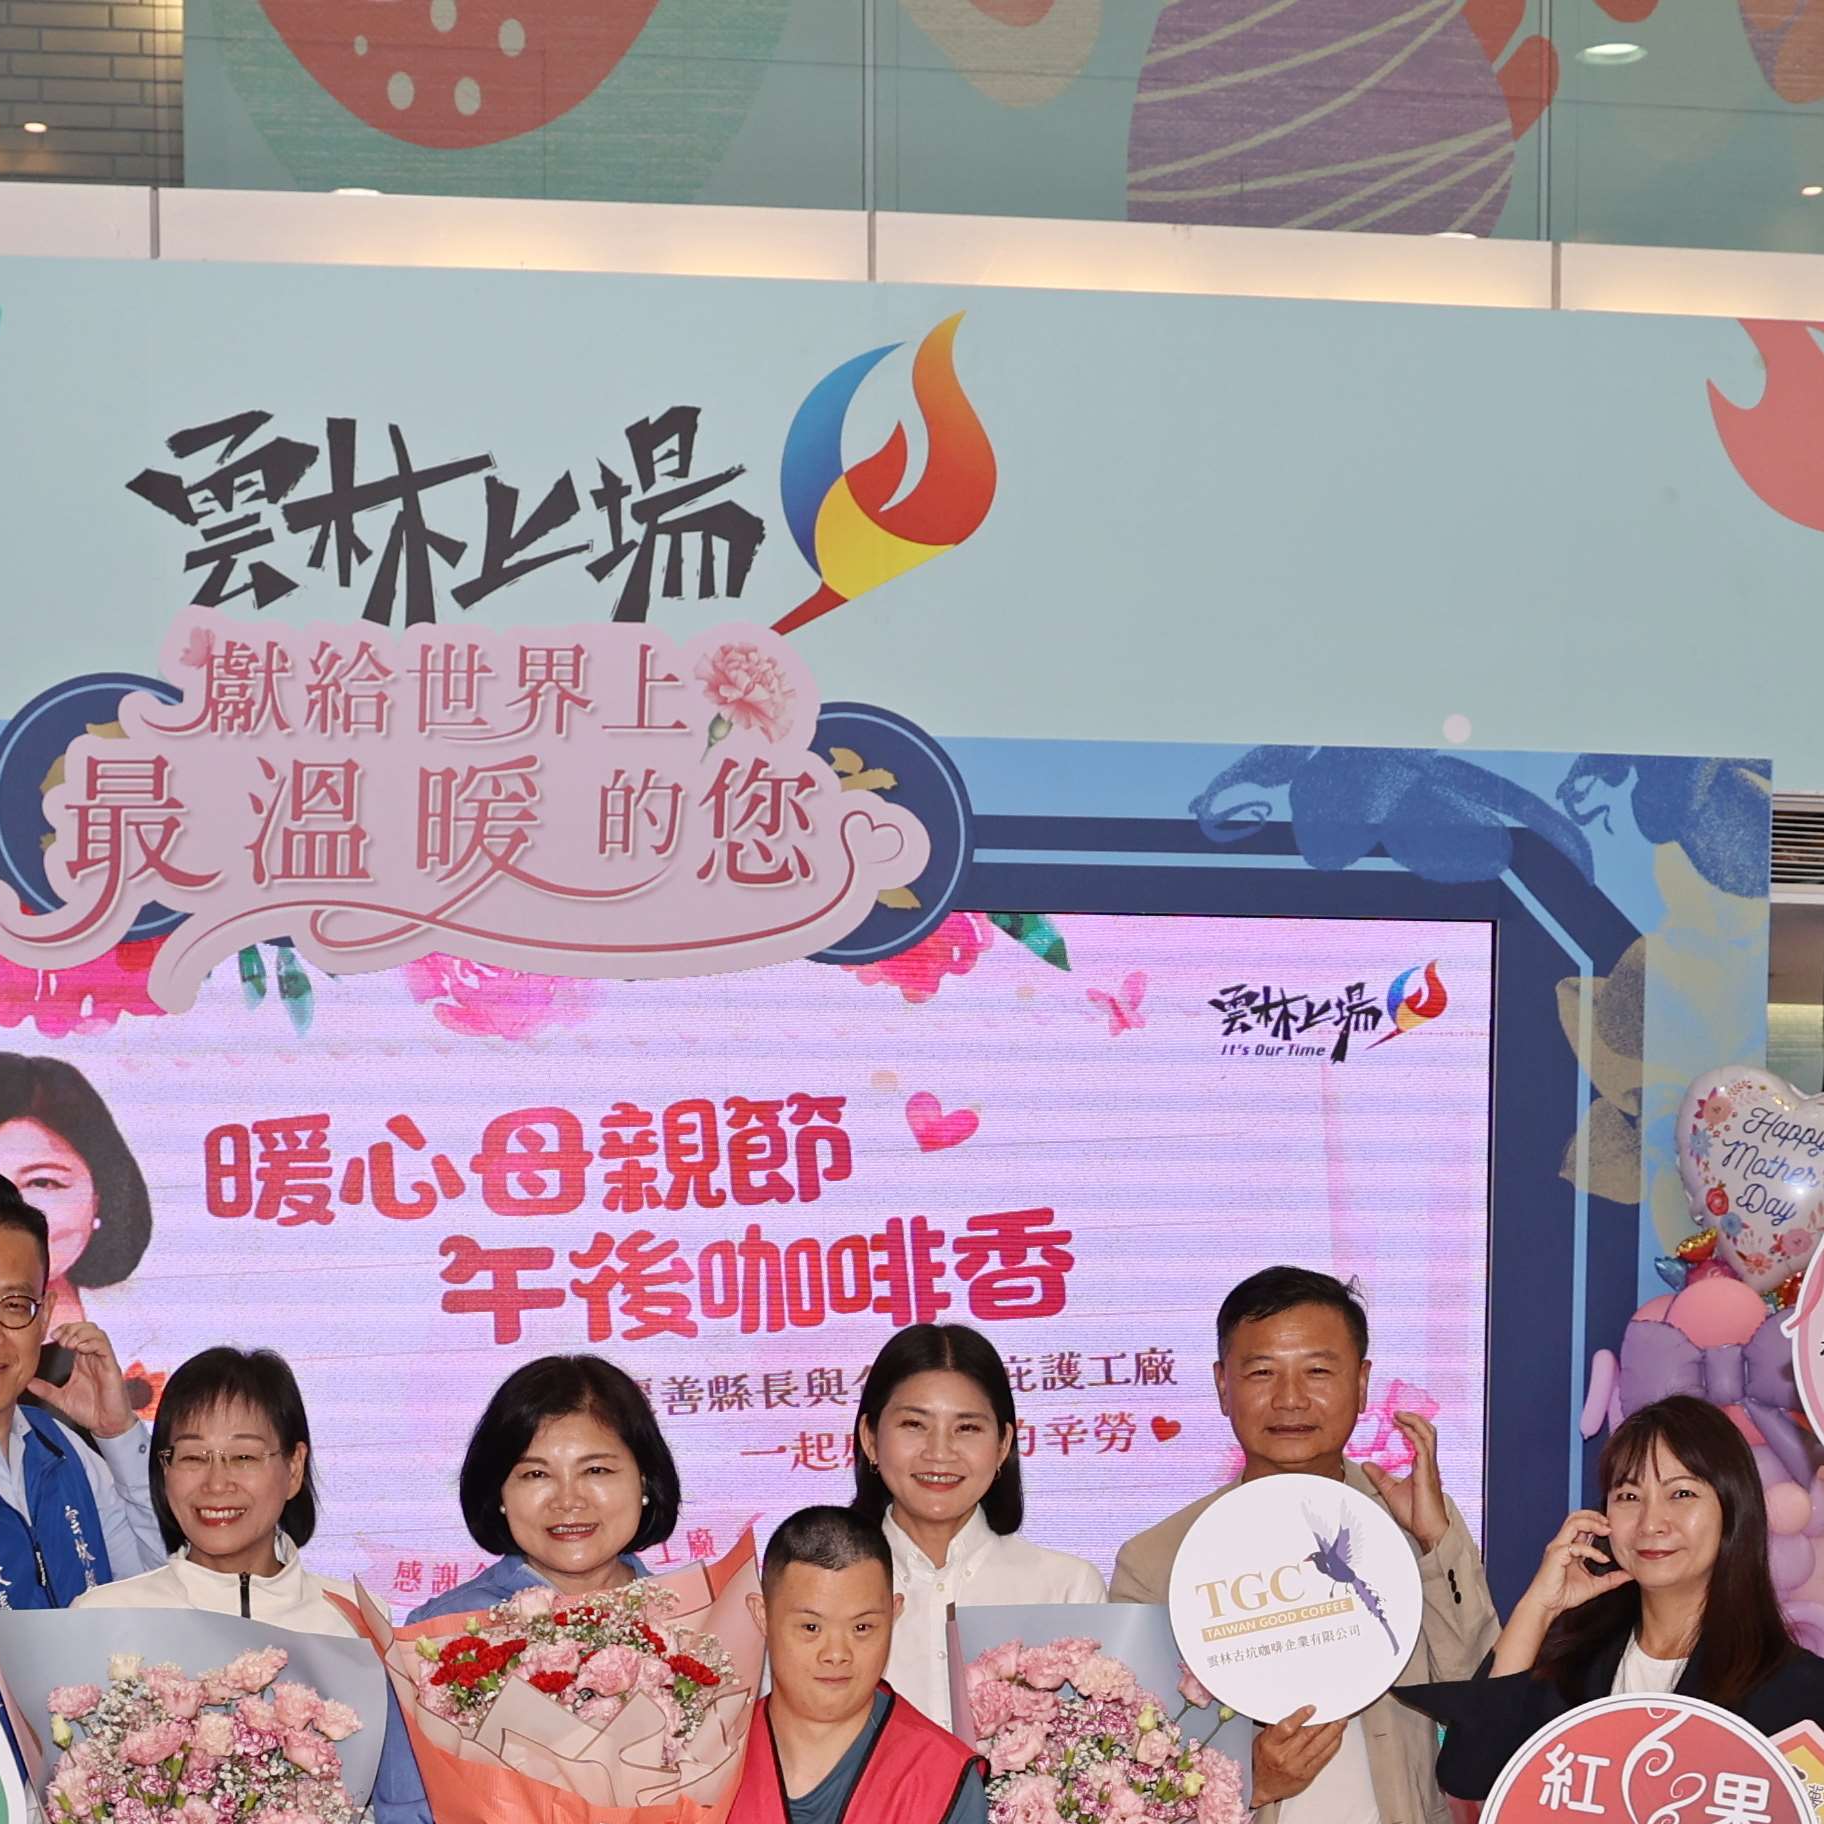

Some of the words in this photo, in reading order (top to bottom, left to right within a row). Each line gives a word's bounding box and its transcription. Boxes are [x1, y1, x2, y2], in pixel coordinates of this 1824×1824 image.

[200, 639, 689, 737] 獻給世界上
[65, 751, 815, 892] 最溫暖的您
[1221, 1044, 1248, 1056] It's
[1255, 1044, 1282, 1056] Our
[1288, 1044, 1325, 1057] Time
[203, 1091, 854, 1229] 暖心母親節
[1736, 1183, 1798, 1226] Day
[439, 1208, 1072, 1345] 午後咖啡香
[1196, 1564, 1305, 1619] TGC
[1206, 1619, 1257, 1639] TAIWAN
[1260, 1611, 1298, 1628] GOOD
[1300, 1601, 1347, 1619] COFFEE
[1207, 1625, 1361, 1668] 雲林古坑咖啡企業有限公司
